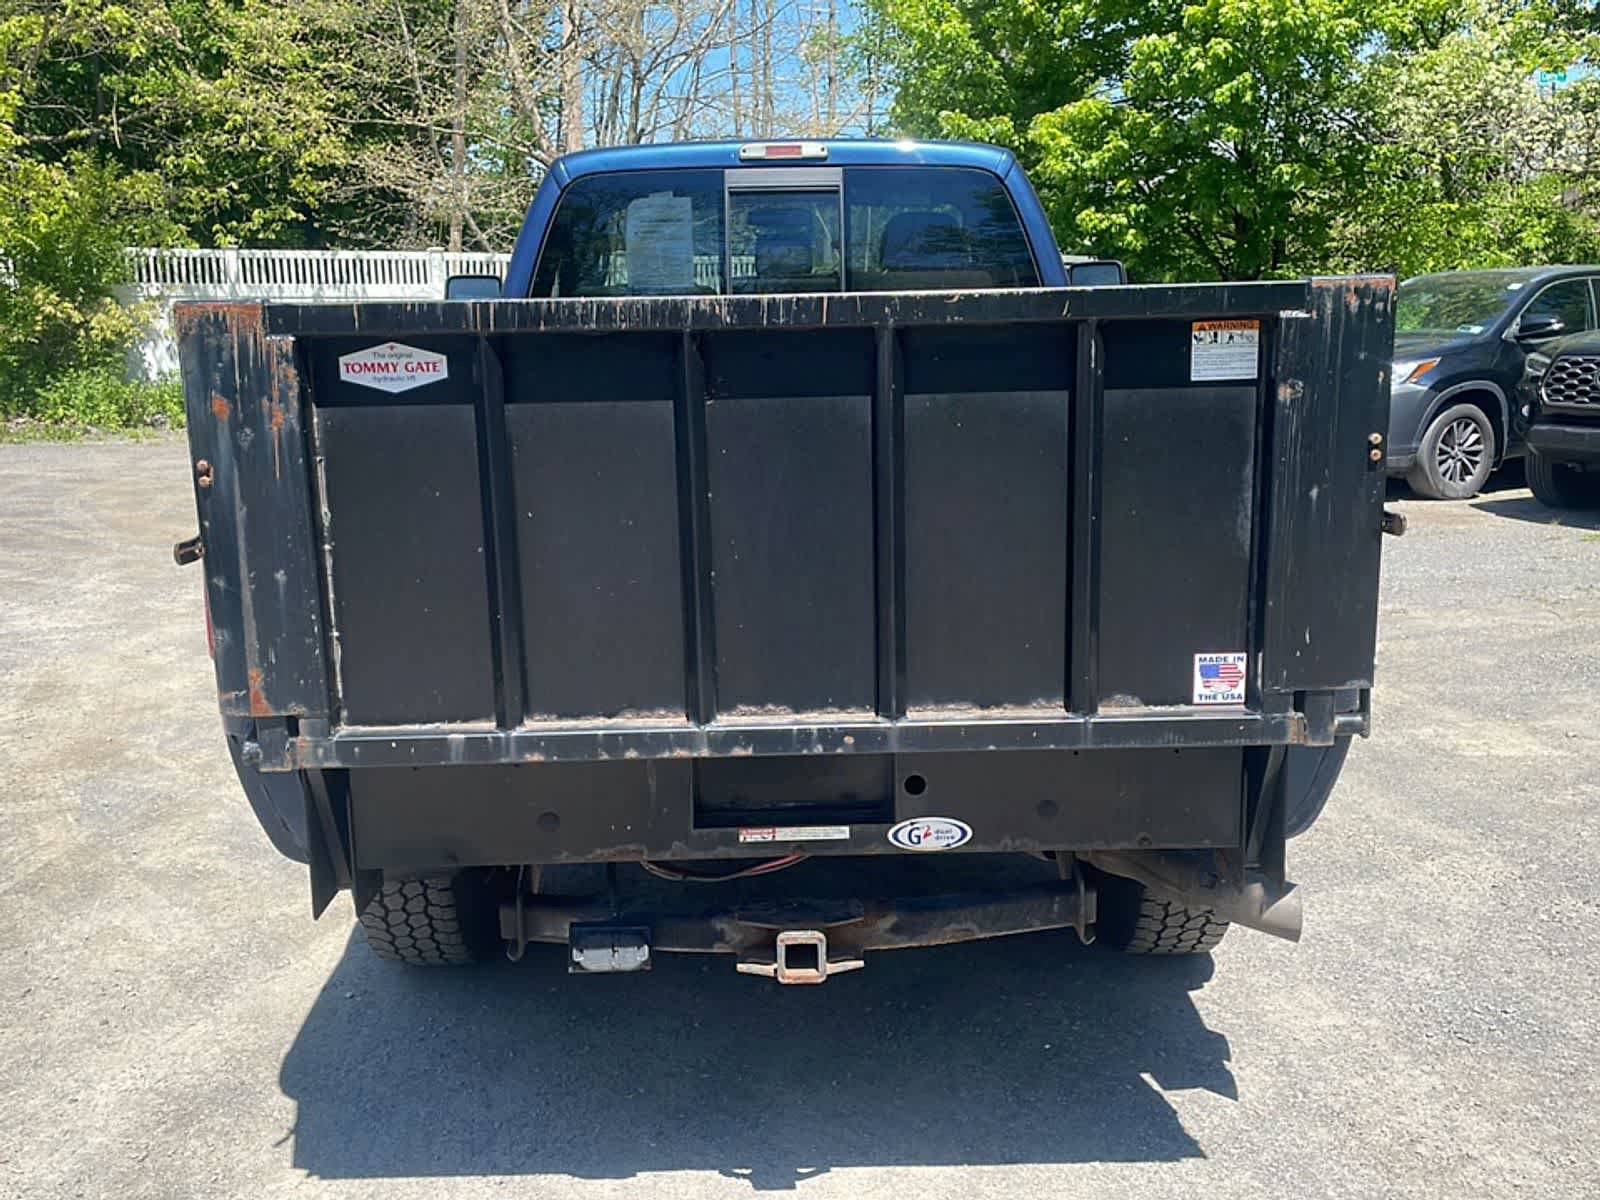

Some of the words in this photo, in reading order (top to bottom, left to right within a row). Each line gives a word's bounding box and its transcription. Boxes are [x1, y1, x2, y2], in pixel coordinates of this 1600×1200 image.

[1208, 321, 1255, 329] WARNING
[344, 362, 399, 374] TOMMY
[404, 361, 441, 373] GATE
[1199, 655, 1230, 663] MADE
[1233, 655, 1245, 663] IN
[1198, 693, 1218, 701] THE
[1222, 693, 1243, 701] USA
